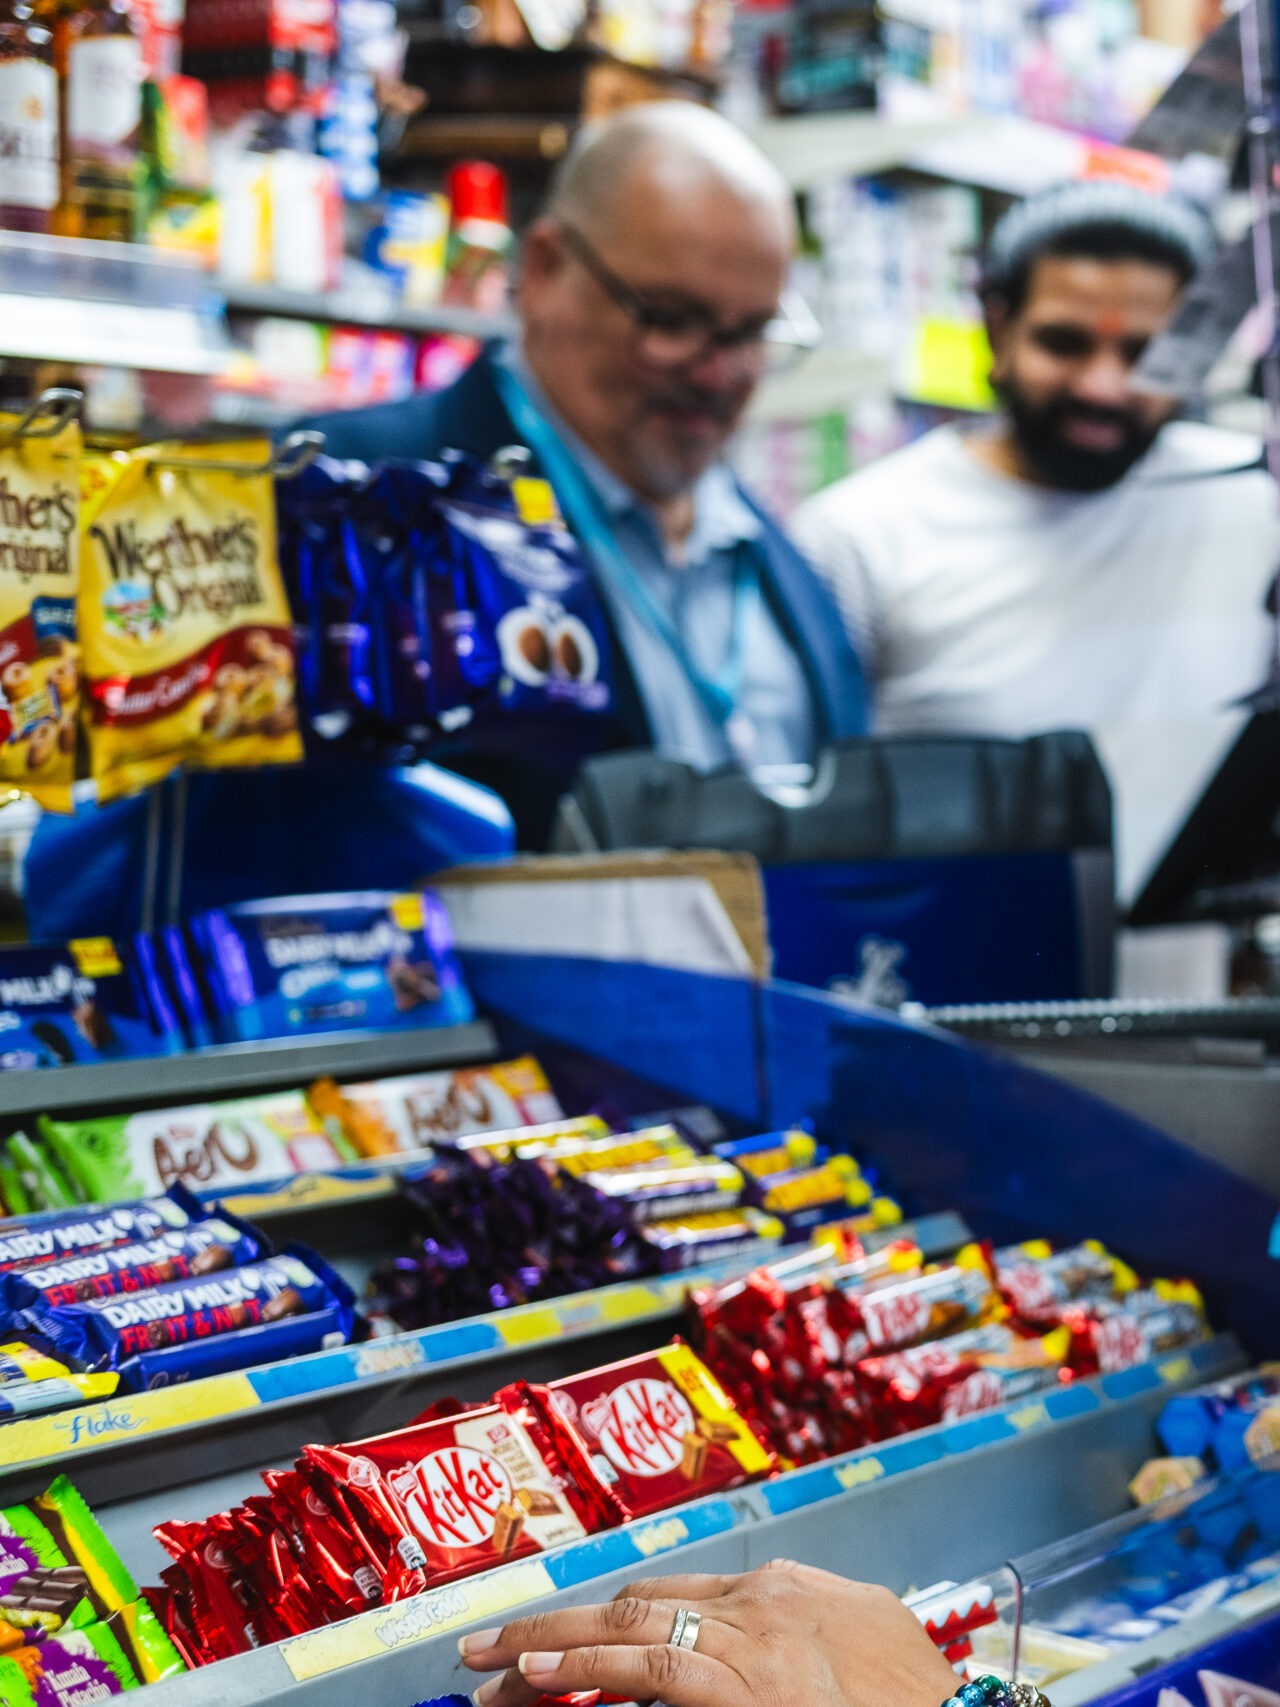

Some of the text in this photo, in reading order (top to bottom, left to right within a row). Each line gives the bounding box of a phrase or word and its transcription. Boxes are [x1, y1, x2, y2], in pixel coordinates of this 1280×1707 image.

[53, 1217, 129, 1249] MILK
[23, 1254, 109, 1289] DAIRY
[107, 1236, 177, 1269] MILK
[119, 1268, 140, 1293] &
[101, 1292, 186, 1329] DAIRY
[182, 1275, 255, 1309] MILK
[193, 1311, 213, 1336] &
[607, 1383, 686, 1471] KitKat
[413, 1451, 504, 1543] KitKat
[375, 1588, 469, 1647] Wispa Gold
